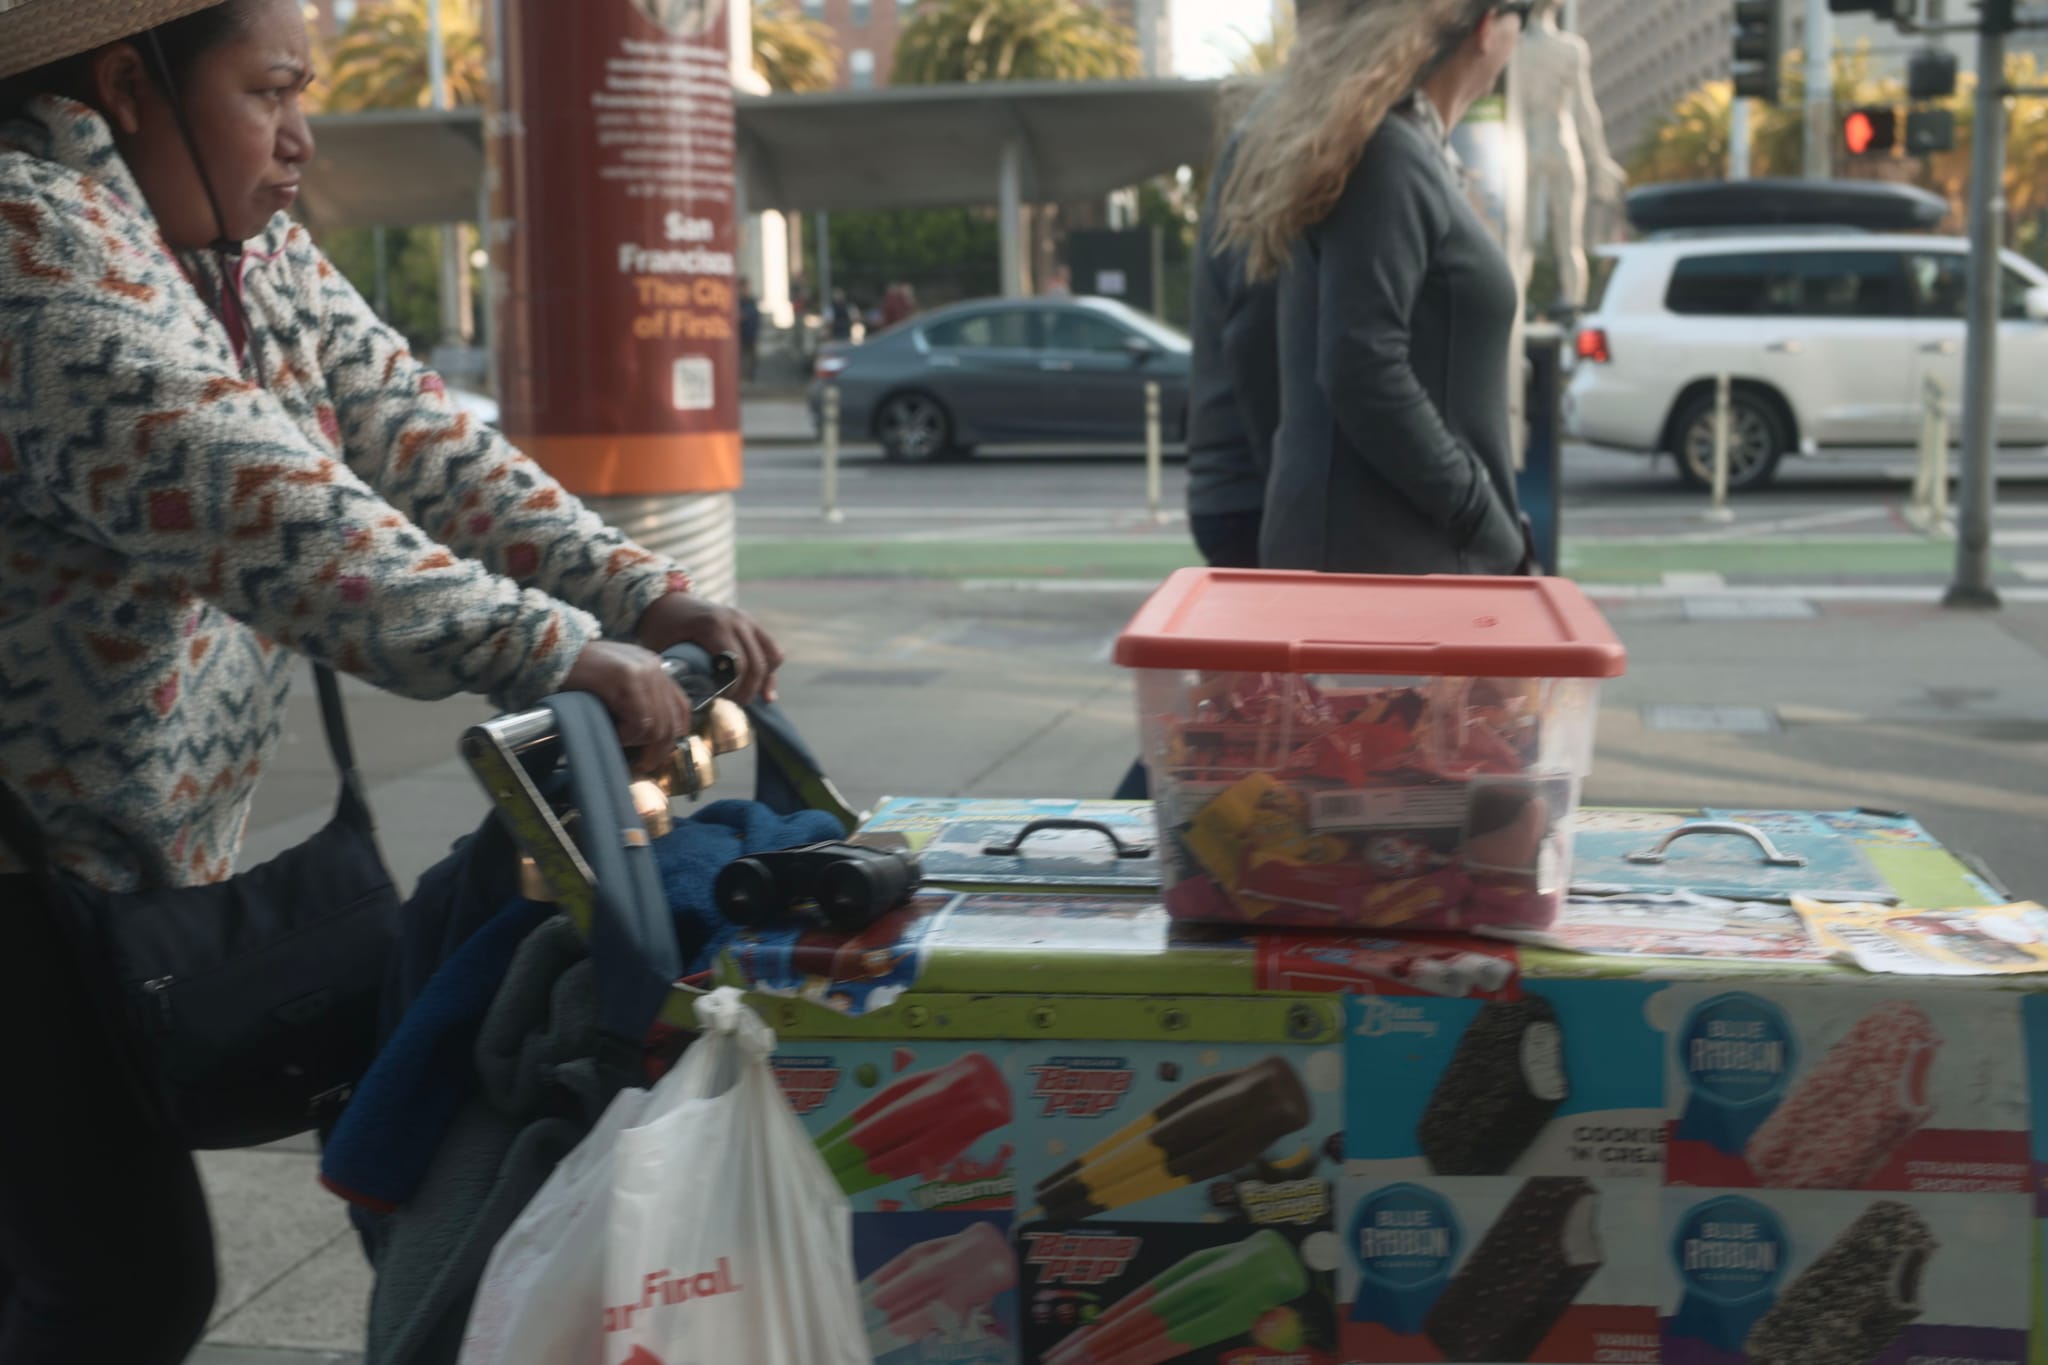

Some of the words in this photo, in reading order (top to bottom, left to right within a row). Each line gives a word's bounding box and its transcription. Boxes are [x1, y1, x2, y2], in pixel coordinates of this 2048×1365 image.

[1709, 1021, 1764, 1037] BLUE
[1573, 1126, 1666, 1143] COOKIE
[1597, 1146, 1665, 1164] CREA
[1378, 1211, 1431, 1226] BLUE
[1703, 1223, 1758, 1238] BLUE
